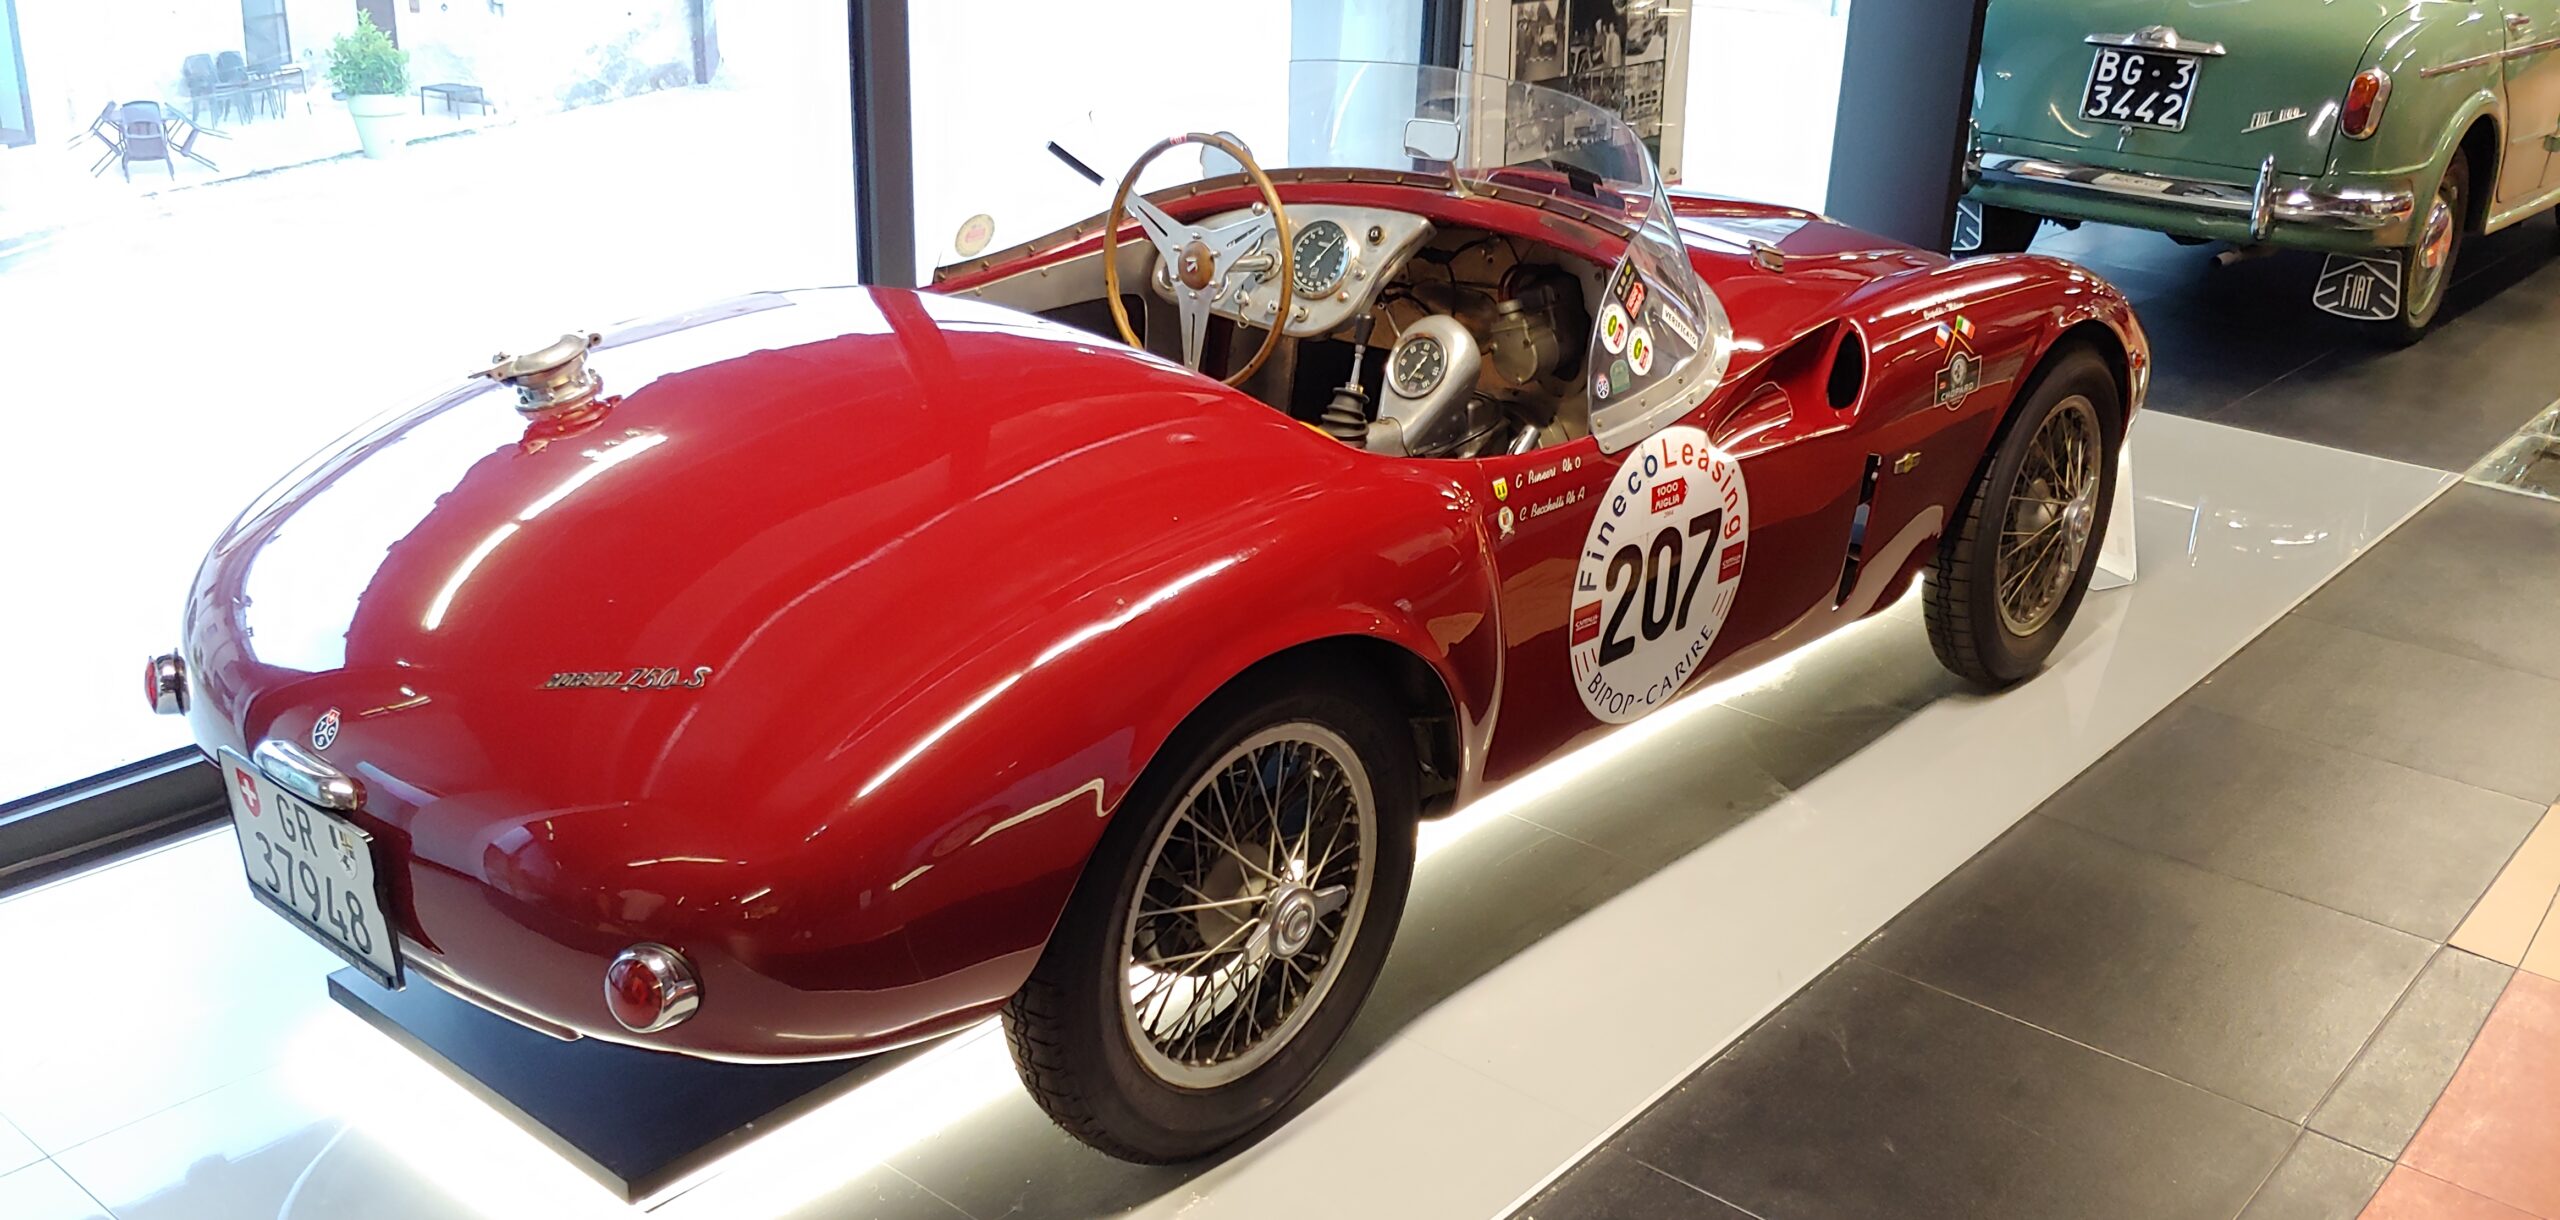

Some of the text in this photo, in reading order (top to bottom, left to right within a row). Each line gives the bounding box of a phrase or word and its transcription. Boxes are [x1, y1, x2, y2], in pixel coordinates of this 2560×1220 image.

[2097, 50, 2145, 85] BG
[2088, 85, 2183, 128] 3442
[2250, 110, 2273, 128] FIAT
[2341, 273, 2375, 310] FIAT
[1657, 481, 1679, 498] 1000
[1597, 507, 1723, 668] 207
[624, 667, 681, 690] 750
[686, 666, 713, 689] S
[1587, 624, 1714, 716] BIPOP-CARIRE
[276, 793, 319, 858] GR
[255, 831, 373, 955] 37948
